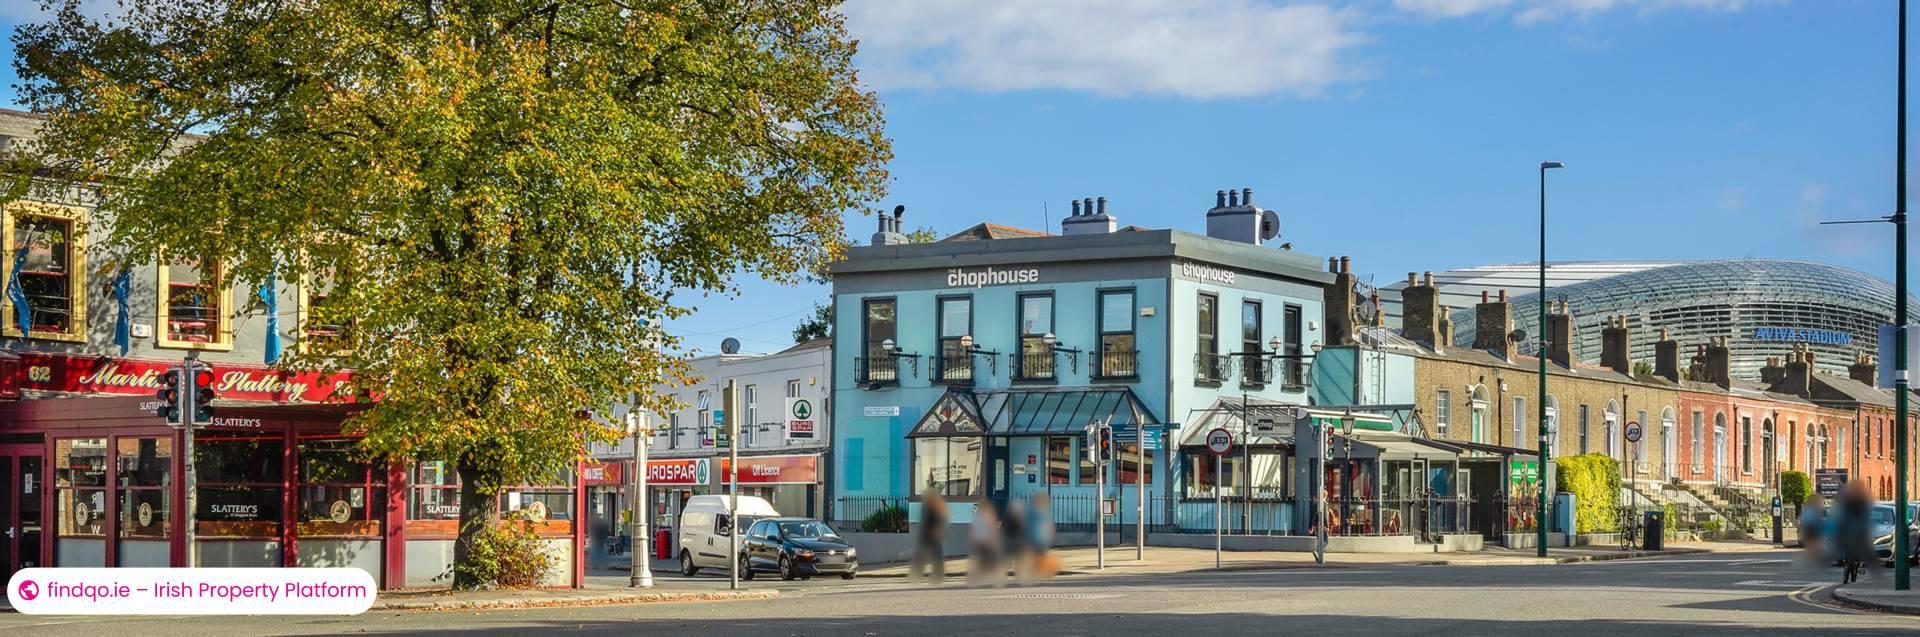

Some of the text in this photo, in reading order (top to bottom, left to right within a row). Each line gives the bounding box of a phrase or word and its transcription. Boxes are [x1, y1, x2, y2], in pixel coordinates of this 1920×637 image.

[948, 267, 1039, 288] chophouse
[1755, 326, 1853, 345] AVIVA STADIUM
[29, 366, 51, 382] 62
[79, 363, 166, 388] Marti
[217, 371, 308, 402] Slattery
[214, 417, 261, 428] SLATTERY'S
[645, 464, 696, 480] UROSPAR
[752, 464, 780, 476] Off Licence
[211, 504, 258, 513] SLATTERY'S
[426, 506, 460, 514] SLATTERY
